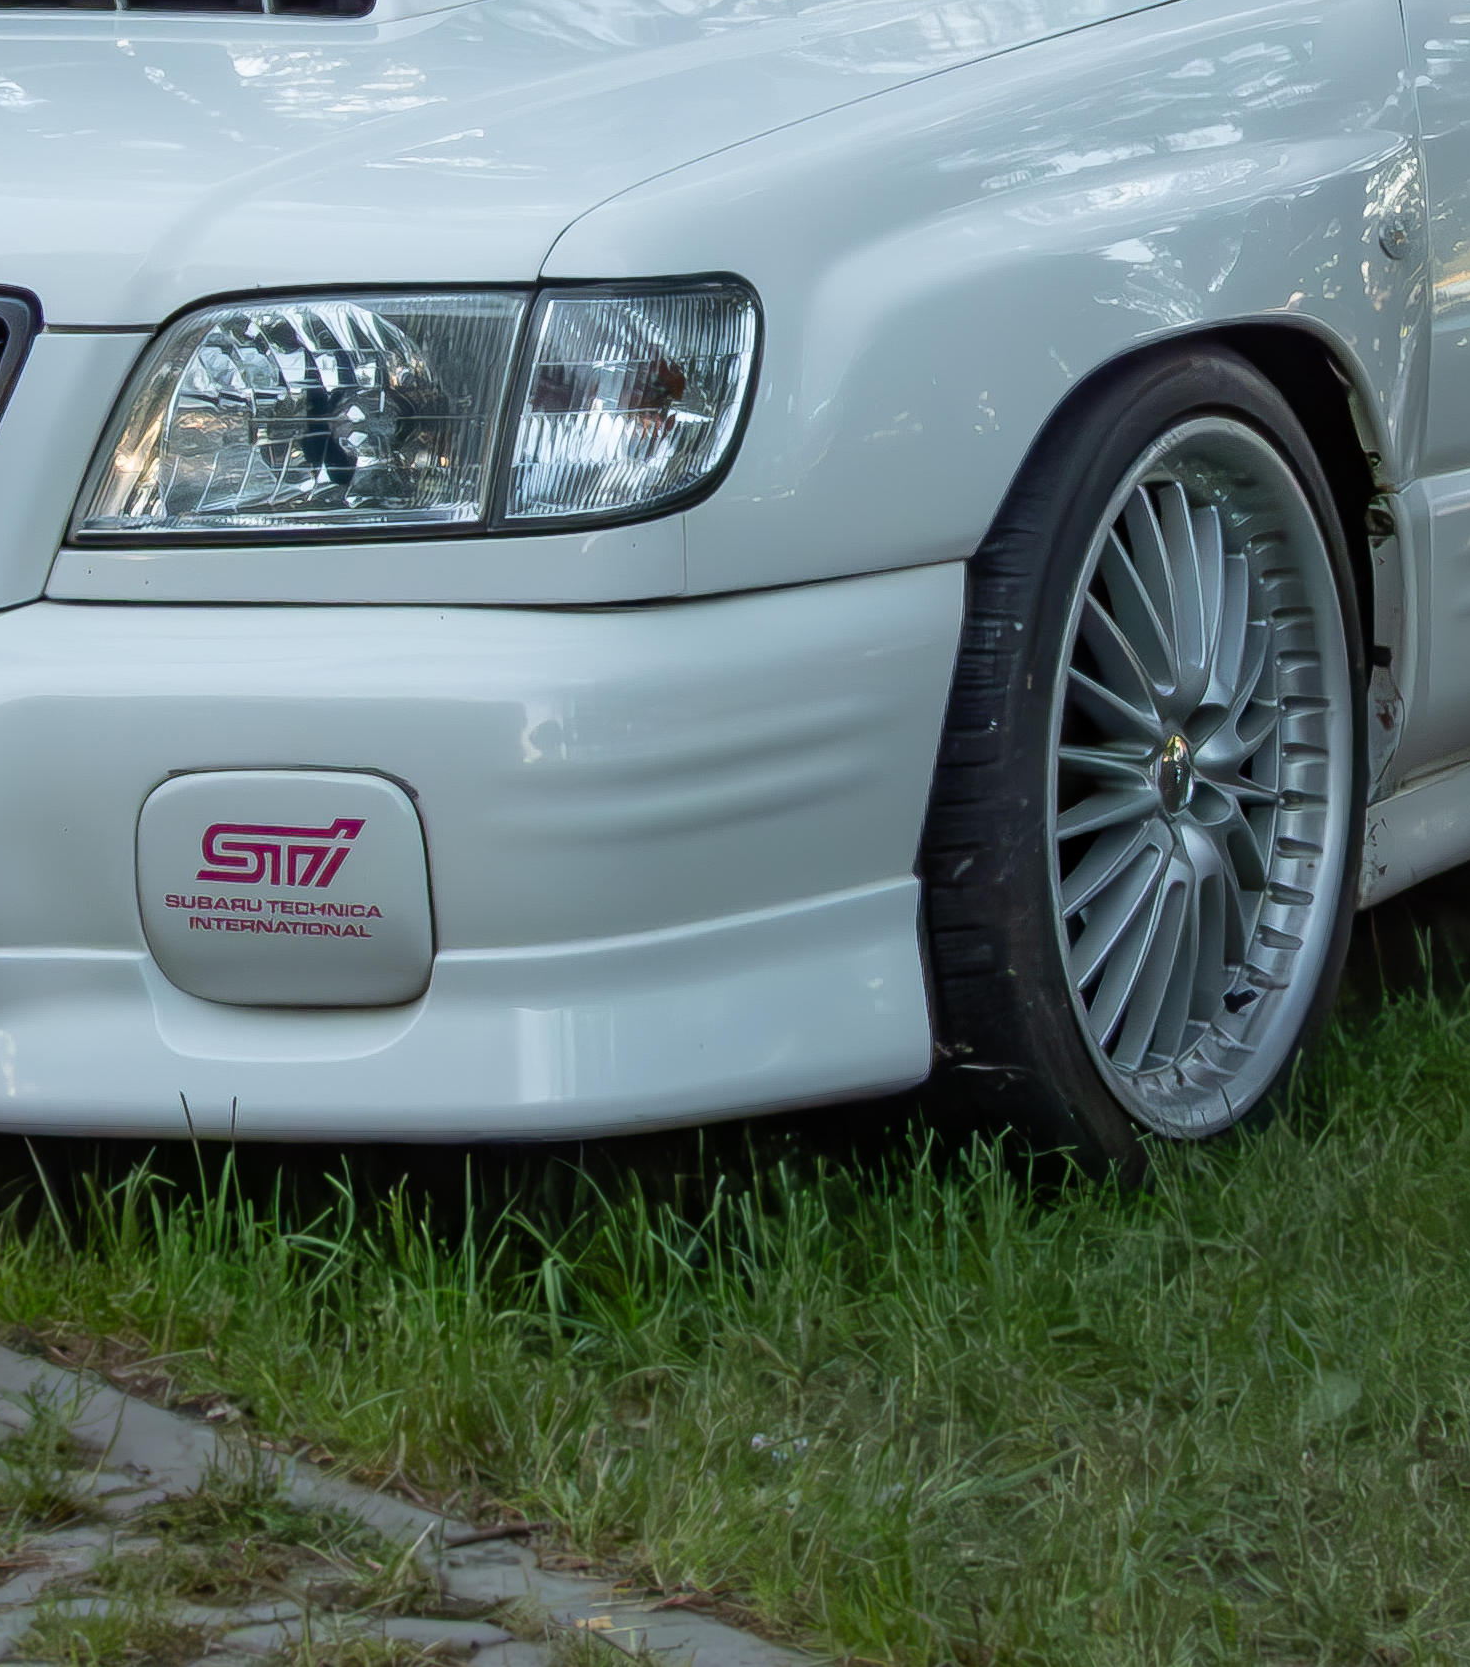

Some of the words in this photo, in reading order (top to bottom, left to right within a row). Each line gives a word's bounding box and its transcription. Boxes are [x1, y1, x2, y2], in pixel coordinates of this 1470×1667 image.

[165, 893, 262, 913] SUBARU
[267, 900, 383, 919] TECHNICA
[189, 916, 372, 938] INTERNATIONAL
